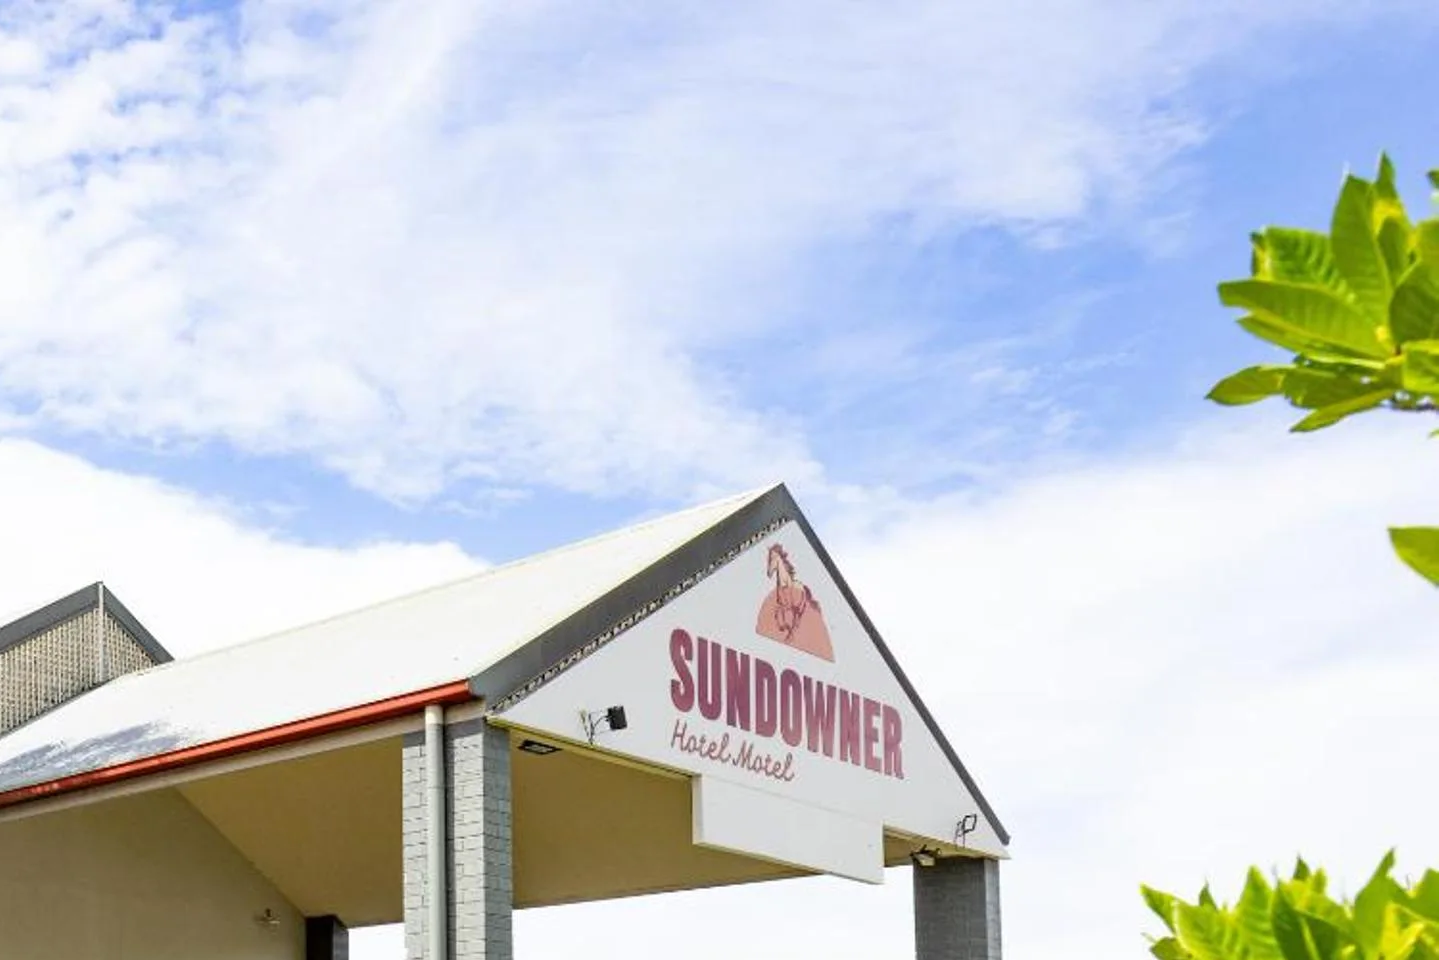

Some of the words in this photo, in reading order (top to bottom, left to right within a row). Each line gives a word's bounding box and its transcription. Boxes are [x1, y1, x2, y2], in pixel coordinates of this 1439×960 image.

[669, 628, 904, 780] SUNDOWNER
[671, 718, 731, 763] Hotel
[732, 740, 795, 782] Motel
